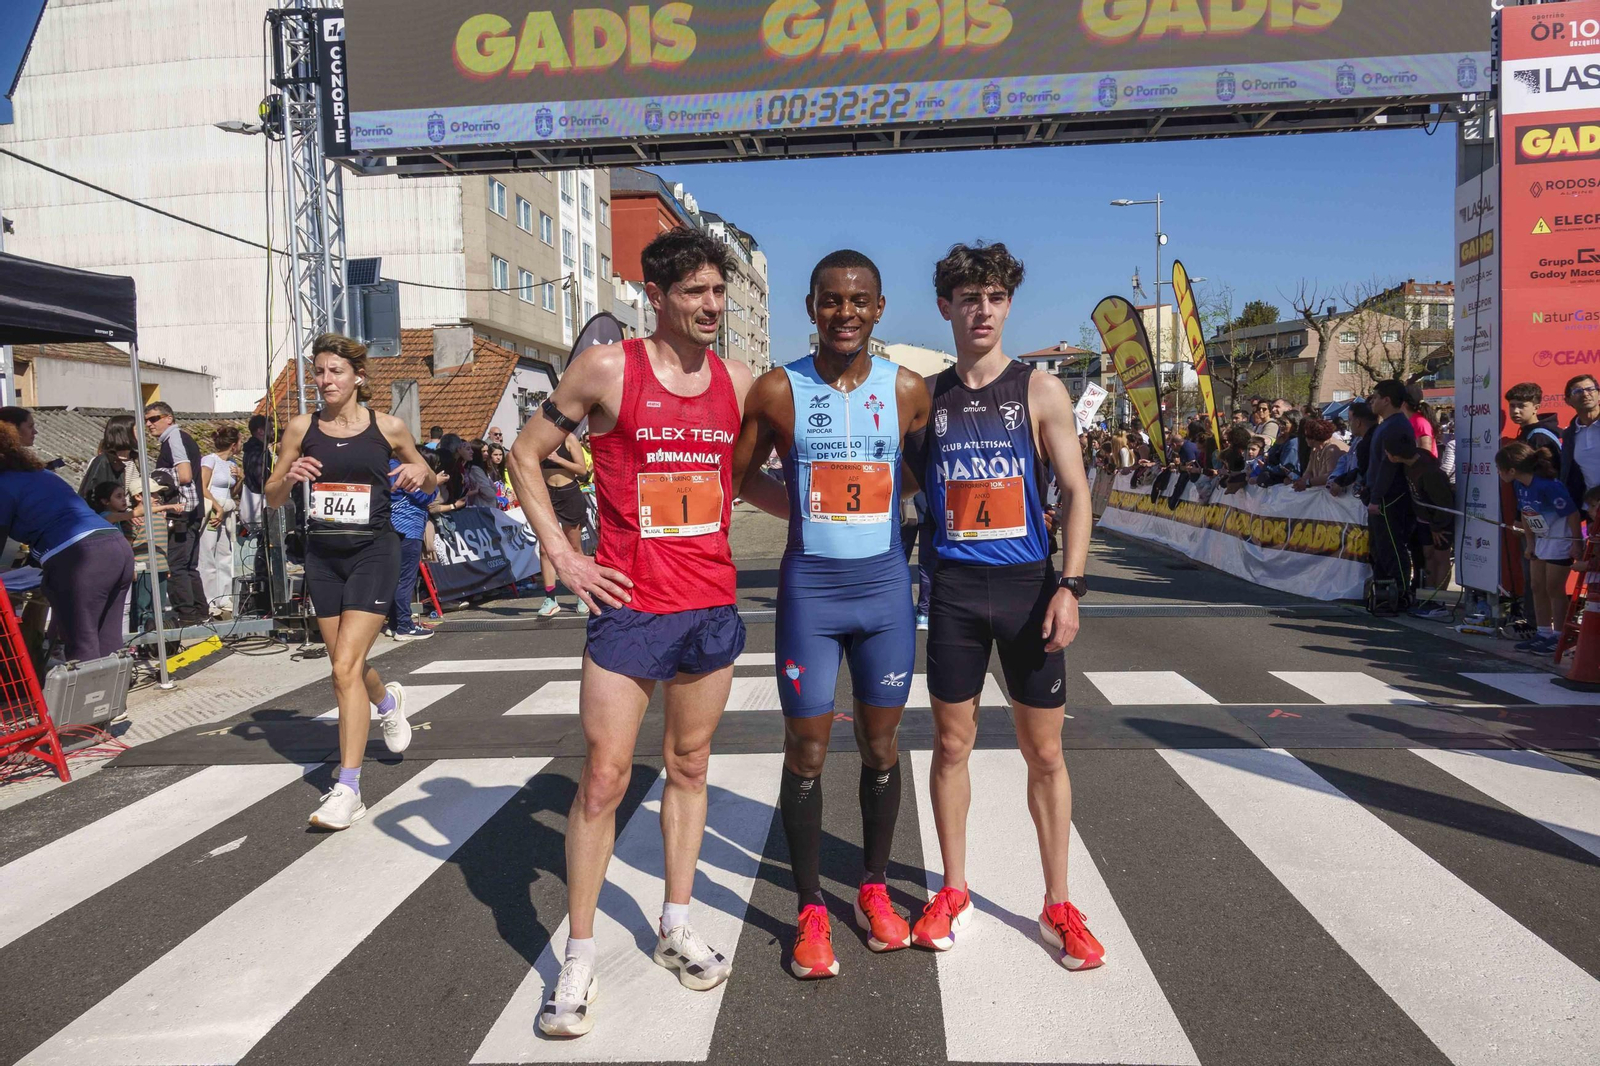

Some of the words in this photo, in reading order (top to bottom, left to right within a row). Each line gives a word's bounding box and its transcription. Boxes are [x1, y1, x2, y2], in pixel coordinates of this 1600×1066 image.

[761, 0, 1013, 60] GADIS
[453, 3, 697, 78] GADIS
[1254, 77, 1297, 90] Porriño
[1375, 71, 1418, 83] Porriño
[1545, 64, 1600, 92] LAS
[331, 46, 346, 143] CCNORTE
[1020, 90, 1061, 102] Porriño
[1137, 84, 1178, 96] Porriño
[767, 88, 910, 125] 00:32:22
[571, 114, 609, 126] Porriño
[680, 108, 720, 120] Porriño
[462, 120, 500, 132] Porriño
[1539, 258, 1574, 267] Grupo
[1530, 270, 1567, 280] Godoy
[1532, 310, 1599, 323] NaturGas
[636, 427, 685, 441] ALEX
[690, 428, 734, 445] TEAM
[811, 441, 862, 450] CONCELLO
[942, 442, 962, 452] CLUB
[647, 448, 721, 464] RUNMANIAK
[817, 452, 829, 460] DE
[830, 451, 857, 460] VIGO
[935, 450, 1026, 484] NARÓN
[847, 484, 860, 511] 3
[324, 497, 356, 516] 844
[681, 495, 688, 523] 1
[976, 501, 991, 527] 4
